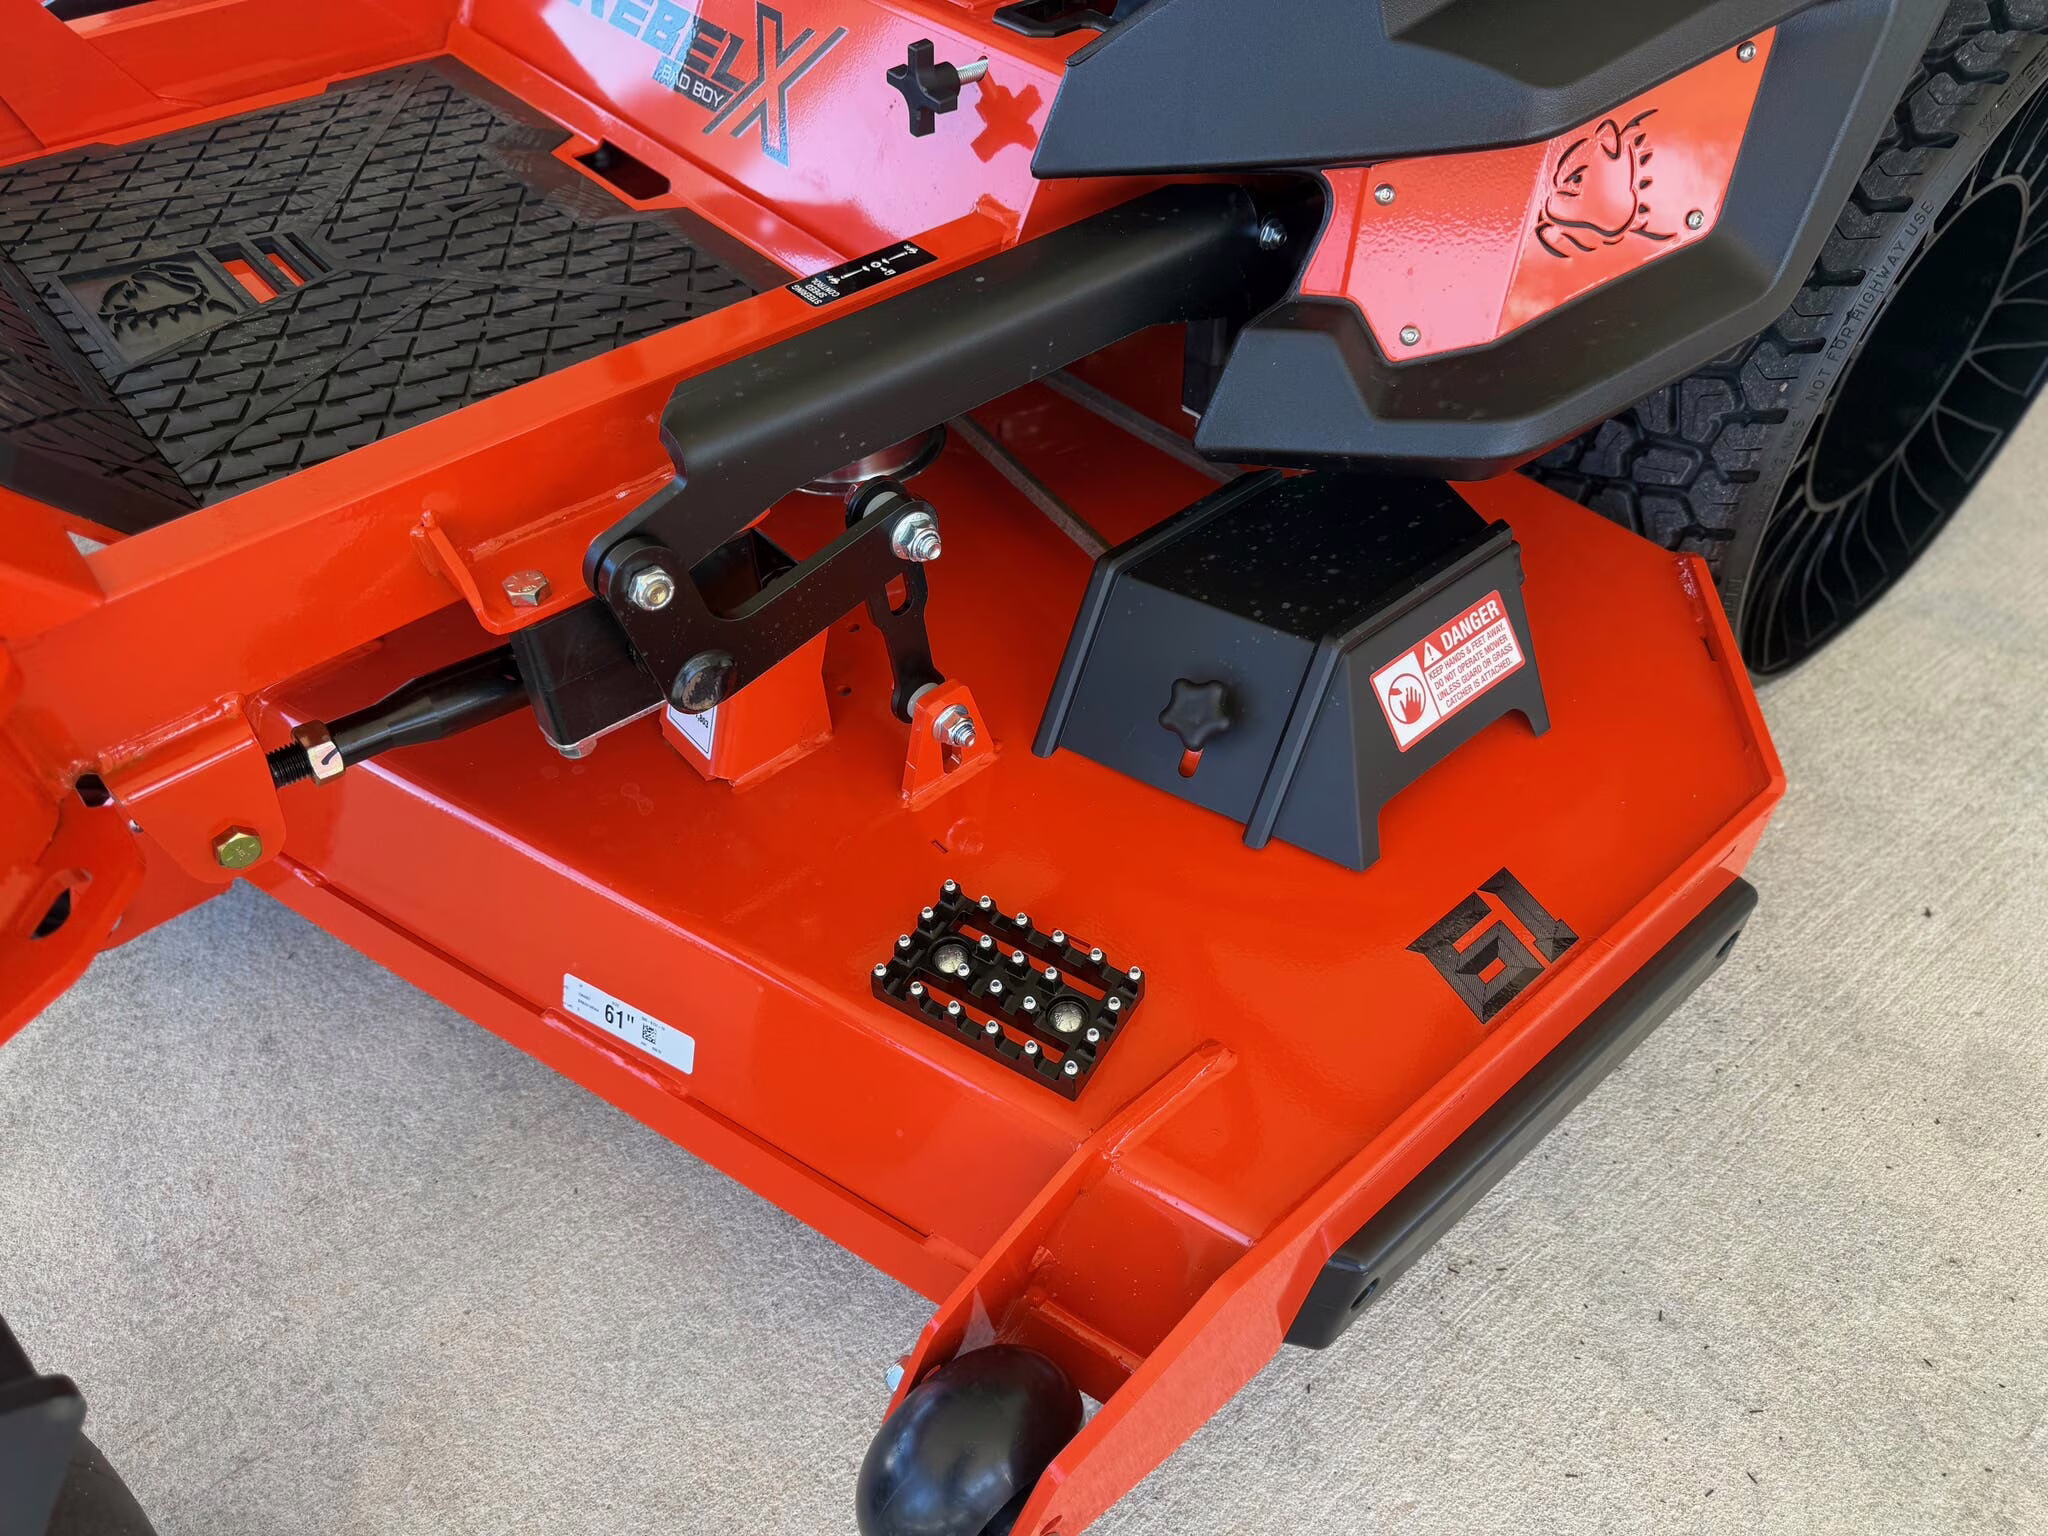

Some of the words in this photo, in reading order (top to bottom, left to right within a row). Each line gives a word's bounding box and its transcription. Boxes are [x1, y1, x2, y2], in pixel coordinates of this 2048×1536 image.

[662, 64, 691, 91] BAD
[692, 77, 725, 107] BOY
[791, 284, 823, 305] STEERING
[804, 284, 828, 299] SPEED
[811, 277, 840, 297] CONTROL
[1804, 369, 1830, 402] NOT
[1827, 327, 1855, 361] FOR
[1850, 244, 1907, 320] HIGHWAY
[1905, 201, 1935, 238] USE
[1440, 600, 1500, 651] DANGER
[1429, 665, 1445, 680] KEEP
[1445, 651, 1466, 669] HANDS
[1465, 646, 1472, 654] &
[1471, 636, 1486, 651] FEET
[1487, 623, 1506, 641] AWAY.
[1434, 678, 1444, 689] DO
[1444, 670, 1457, 682] NOT
[1458, 653, 1485, 672] OPERATE
[1484, 634, 1508, 654] MOWER
[1436, 680, 1461, 701] UNLESS
[1461, 665, 1482, 684] GUARD
[1482, 659, 1491, 671] OR
[1492, 643, 1513, 662] GRASS
[1445, 685, 1473, 708] CATCHER
[1473, 679, 1480, 689] IS
[1481, 657, 1511, 684] ATTACHED.
[605, 1003, 634, 1029] 61"
